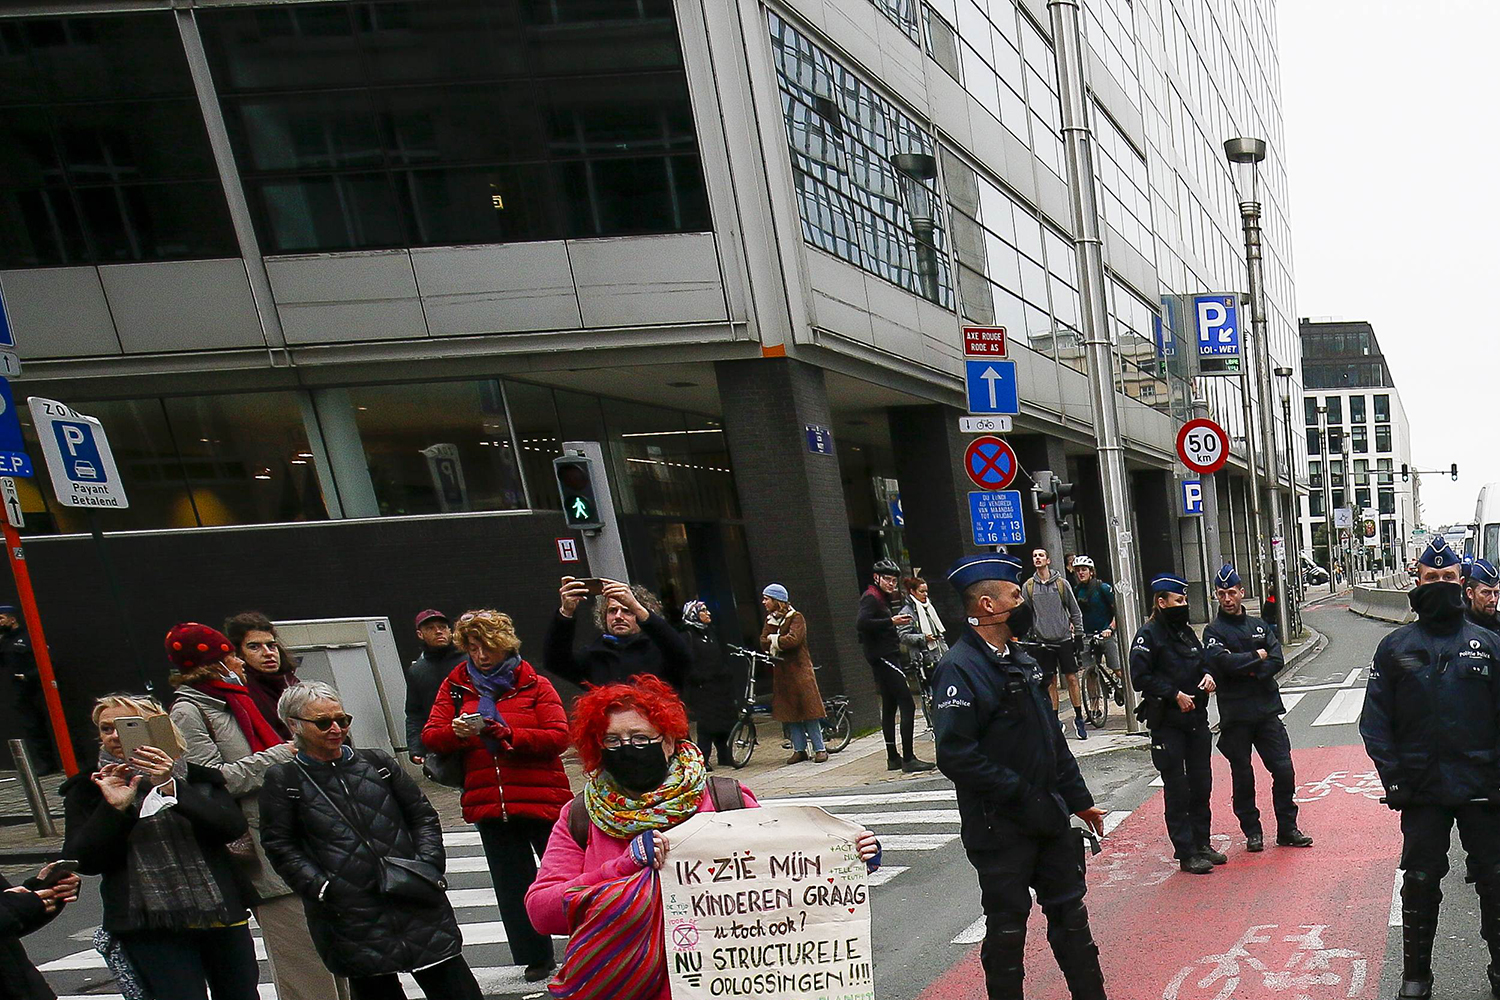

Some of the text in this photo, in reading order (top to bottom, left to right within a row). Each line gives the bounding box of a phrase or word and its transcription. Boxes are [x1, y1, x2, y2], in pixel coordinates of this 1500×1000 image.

[1198, 302, 1227, 340] P
[966, 332, 1002, 342] AXE ROUGE
[970, 343, 999, 352] RODE AS
[43, 402, 79, 418] ZON
[62, 425, 84, 456] P
[1188, 434, 1216, 453] 50
[1196, 454, 1212, 462] km
[72, 483, 110, 495] Payant
[71, 495, 118, 506] Betalend
[988, 522, 994, 530] 7
[1010, 520, 1020, 530] 13
[988, 532, 998, 542] 16
[1011, 532, 1022, 541] 18
[562, 542, 574, 558] H
[676, 860, 702, 886] IK
[712, 853, 757, 883] ZIE
[691, 884, 866, 916] KINDEREN GRAAG
[731, 920, 765, 940] toch
[675, 952, 702, 974] NU
[713, 938, 862, 972] STRUCTURELE
